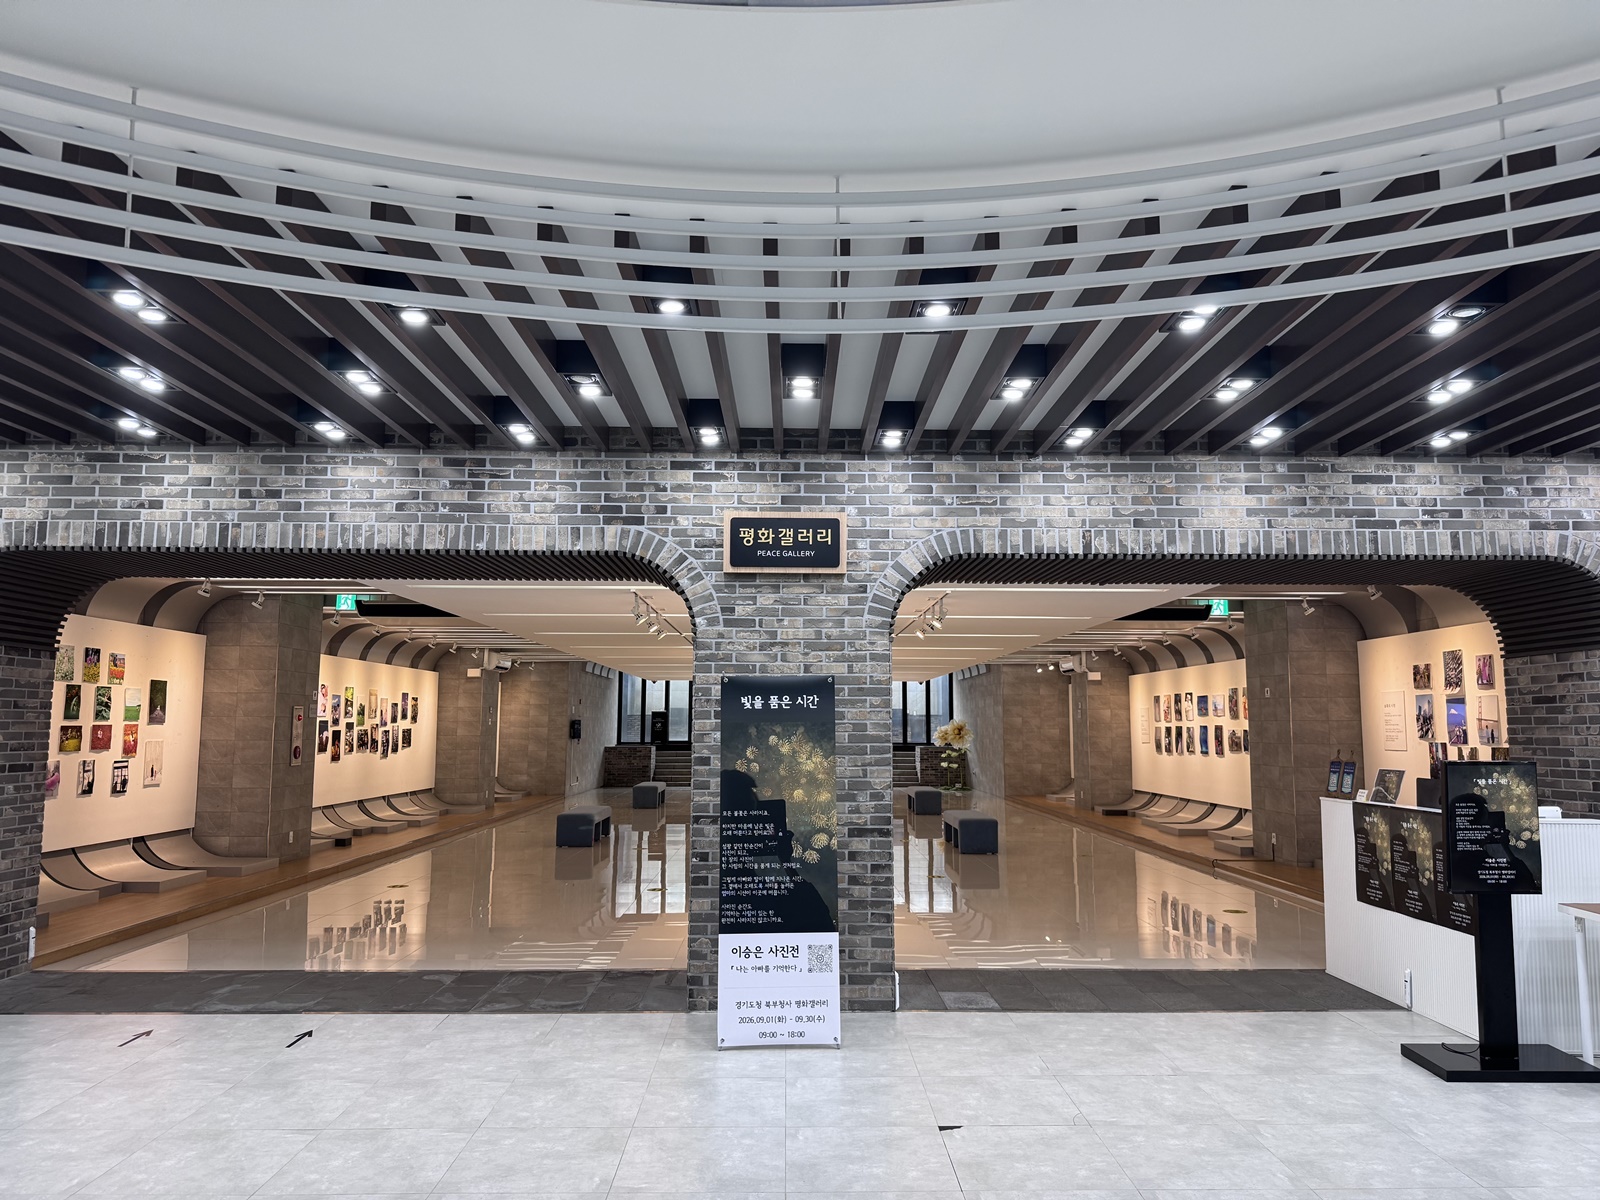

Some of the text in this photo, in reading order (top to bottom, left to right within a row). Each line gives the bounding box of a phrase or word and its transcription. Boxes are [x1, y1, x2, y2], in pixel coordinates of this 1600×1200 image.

[739, 527, 832, 546] 평화갤러리
[741, 694, 819, 709] 빛을 품은 시간
[731, 944, 799, 959] 이승은 사진전
[751, 965, 770, 973] 아빠를
[735, 999, 829, 1010] 경기도청 북부청사 평화갤러리
